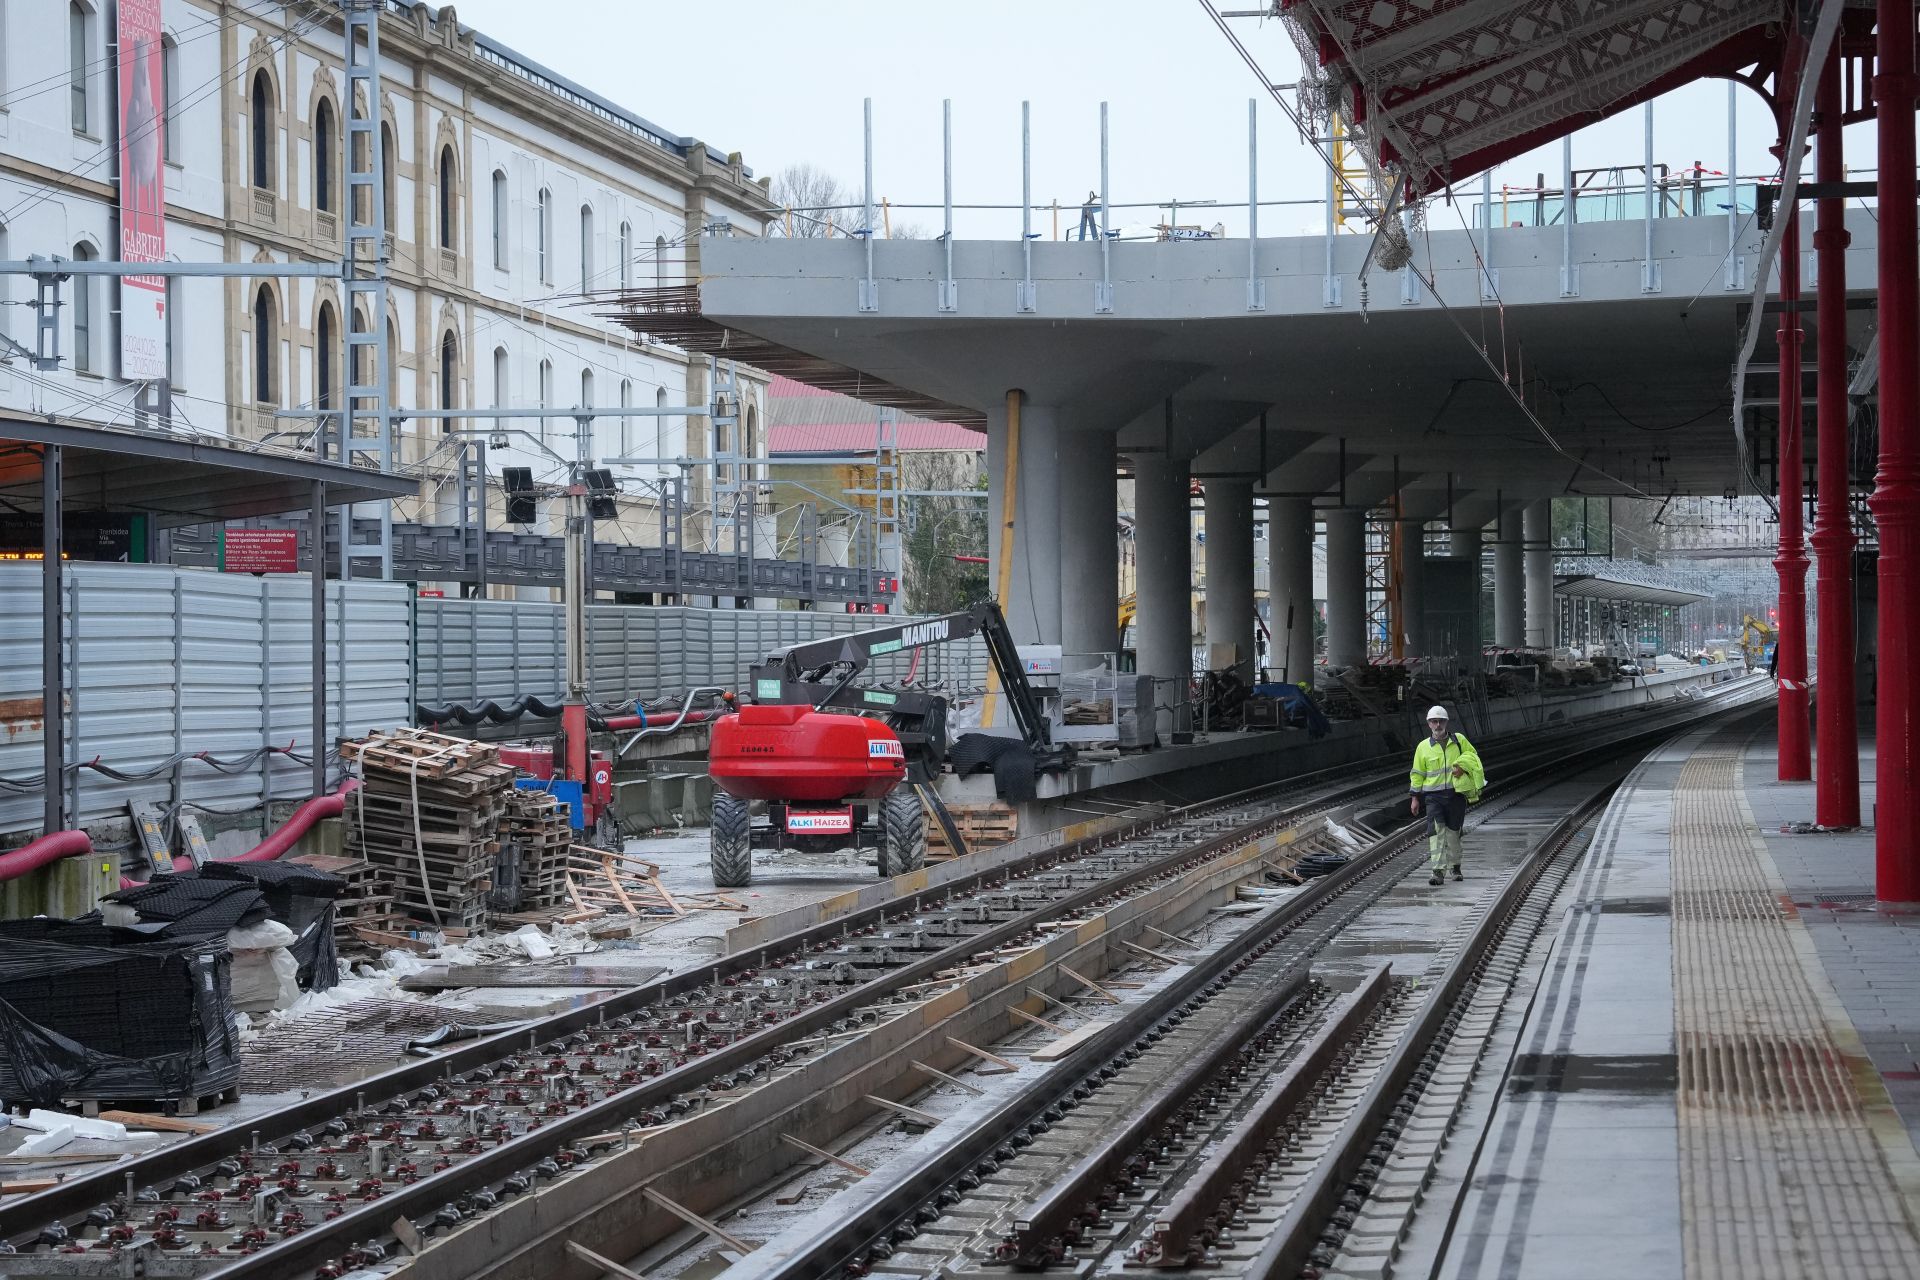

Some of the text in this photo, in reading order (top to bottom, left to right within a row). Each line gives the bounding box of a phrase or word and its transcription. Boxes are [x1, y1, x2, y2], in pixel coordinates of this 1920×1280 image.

[123, 227, 165, 260] GABRIEL
[901, 619, 949, 648] MANITOU
[870, 744, 886, 754] ALKI
[790, 818, 849, 827] ALKI HAIZEA
